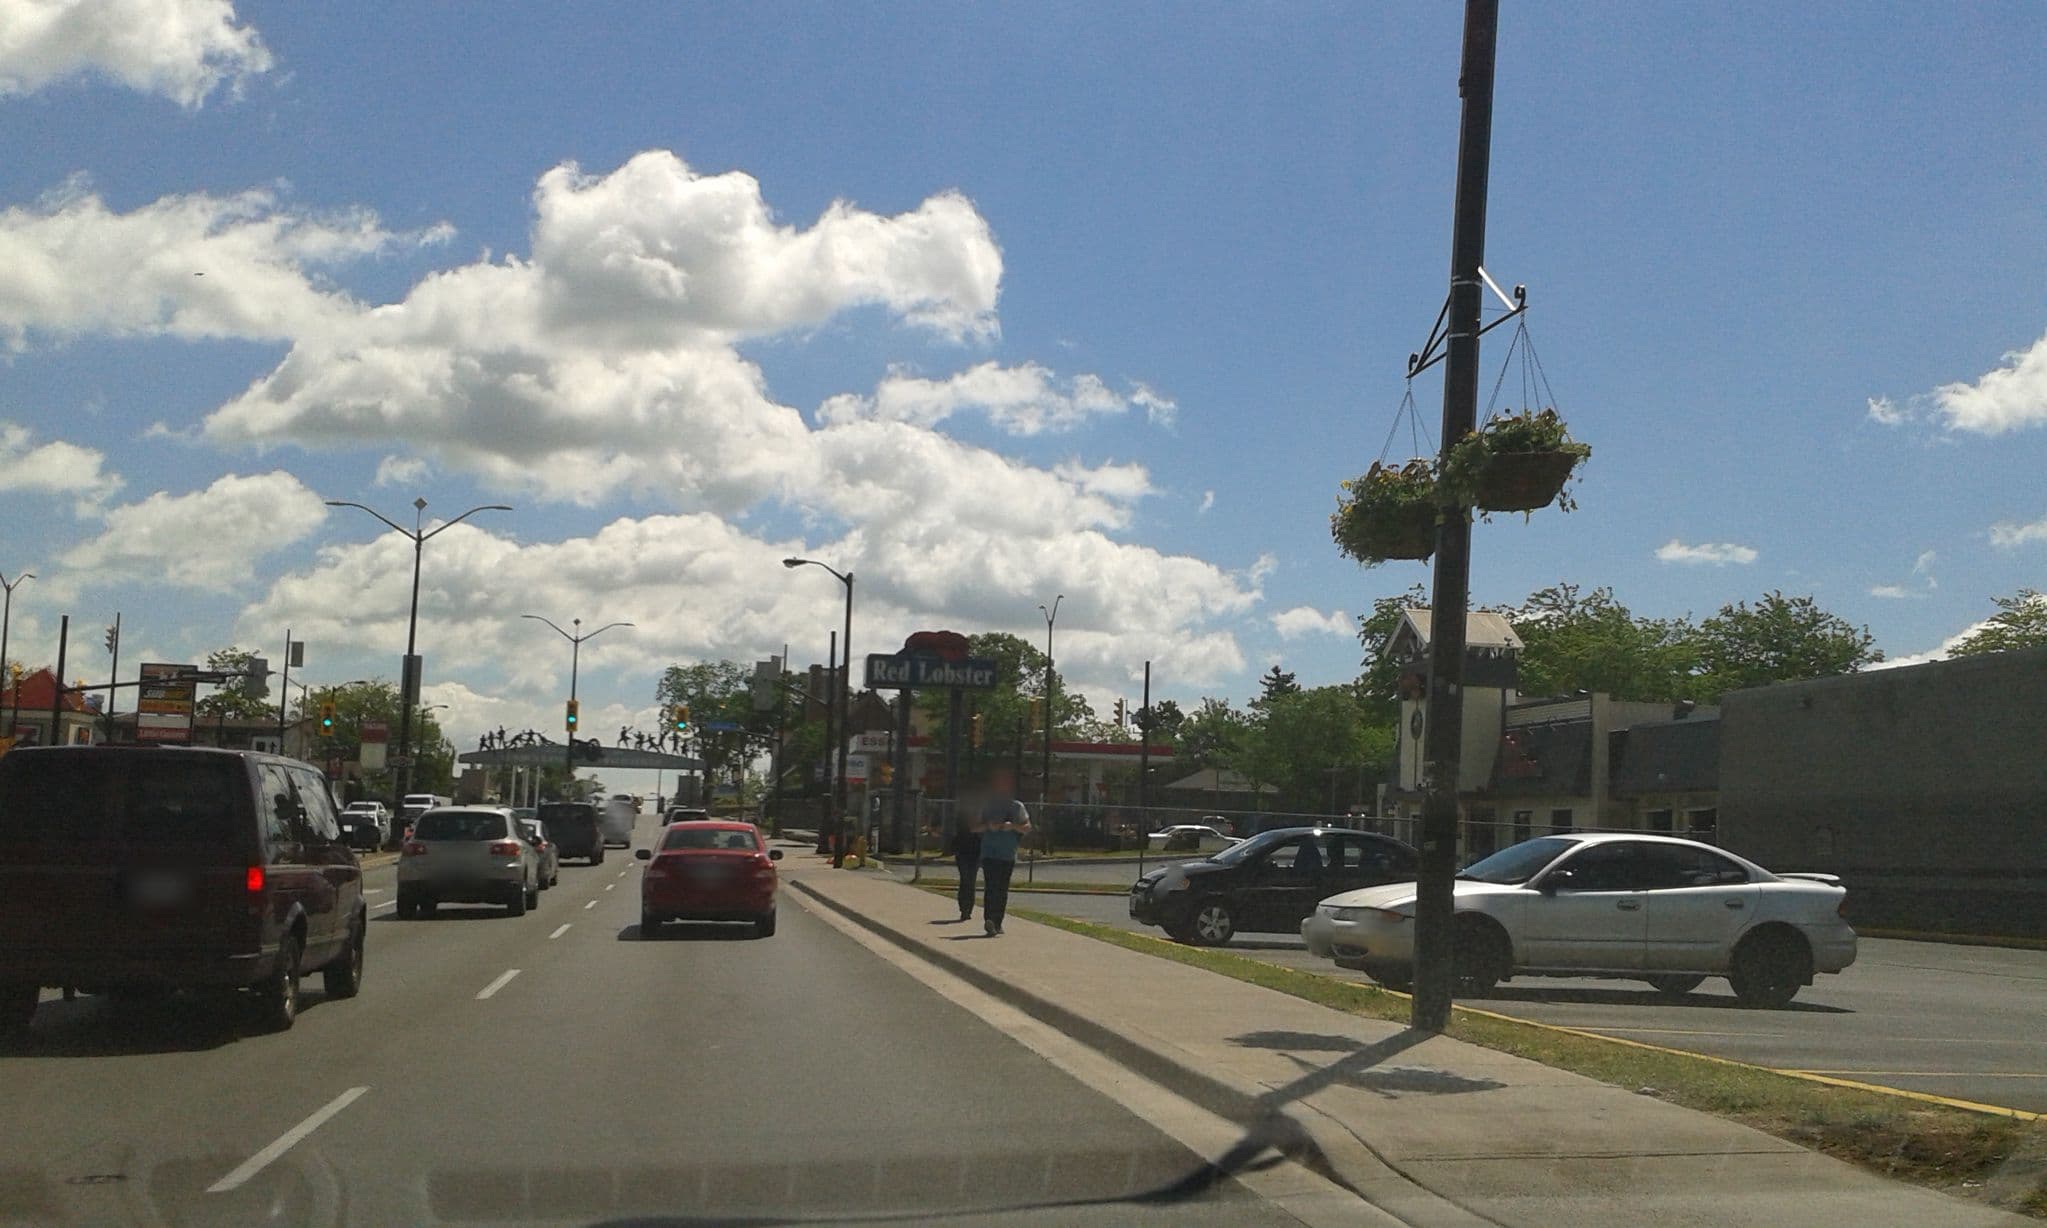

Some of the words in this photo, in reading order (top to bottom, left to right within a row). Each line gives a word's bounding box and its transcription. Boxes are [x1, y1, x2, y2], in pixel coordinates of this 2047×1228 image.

[873, 660, 911, 682] Red
[918, 661, 993, 685] Lobster
[143, 688, 193, 699] SUB
